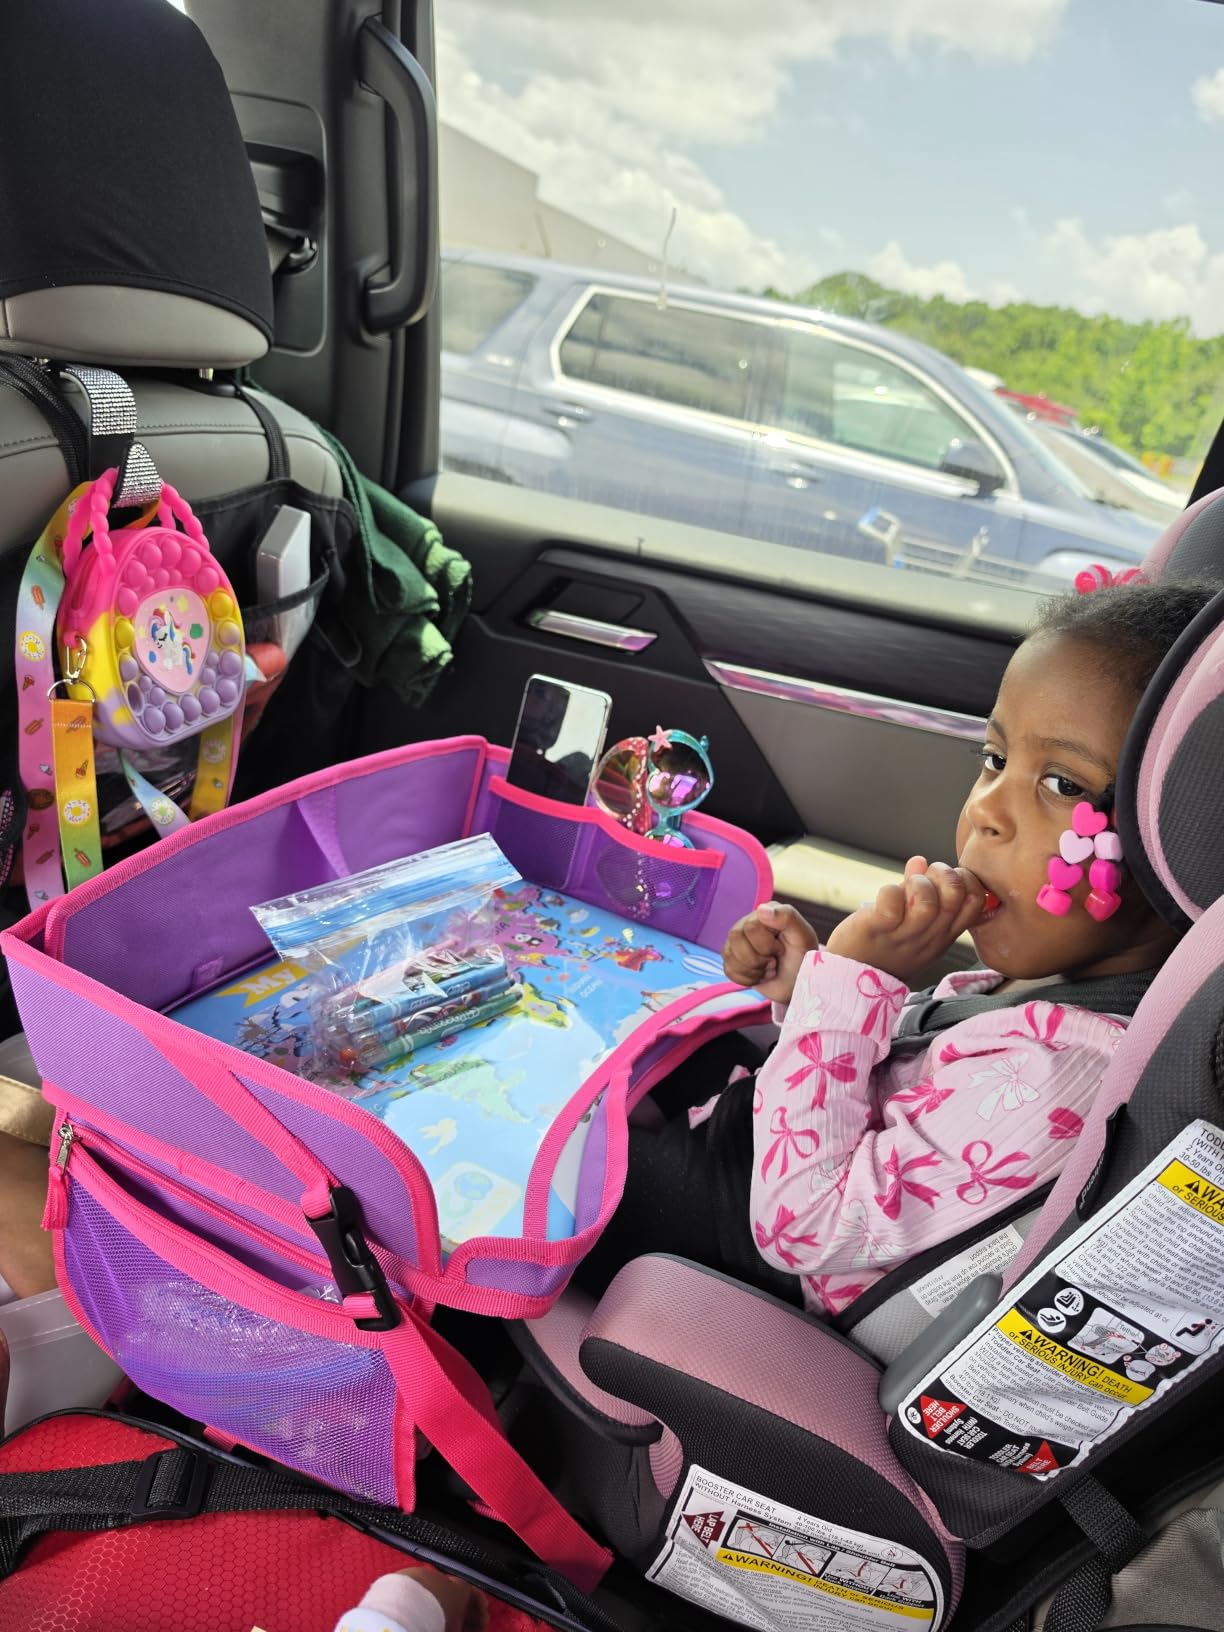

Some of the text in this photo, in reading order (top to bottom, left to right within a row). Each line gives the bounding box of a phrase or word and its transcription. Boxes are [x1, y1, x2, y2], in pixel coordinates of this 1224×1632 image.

[239, 968, 296, 995] My
[1178, 1151, 1200, 1168] 30-50
[1185, 1144, 1214, 1166] 2 Years
[1191, 1137, 1220, 1158] (WITH
[1148, 1192, 1213, 1239] child restraint around
[1155, 1185, 1223, 1235] Snugly adjust harness
[1171, 1184, 1224, 1221] or SERIOUS
[1113, 1221, 1138, 1242] system
[1137, 1238, 1145, 1246] if
[1142, 1243, 1172, 1264] available
[1122, 1216, 1191, 1266] vehicle's child restraint
[1128, 1210, 1152, 1230] Secure
[1150, 1227, 1164, 1239] this
[1163, 1236, 1180, 1249] child
[1133, 1205, 1205, 1254] provided with this child
[1141, 1198, 1220, 1254] Secure the top anchorage
[976, 1250, 994, 1265] second
[1078, 1253, 1098, 1272] Check
[1096, 1237, 1108, 1249] kg)
[1106, 1246, 1121, 1258] and
[1119, 1255, 1141, 1273] whose
[1100, 1252, 1114, 1264] and
[1102, 1232, 1117, 1245] who
[1116, 1243, 1136, 1260] weigh
[1135, 1256, 1162, 1276] between
[1161, 1273, 1172, 1282] 30
[1109, 1226, 1123, 1240] Use
[1122, 1237, 1137, 1251] only
[1136, 1248, 1150, 1260] with
[1149, 1257, 1175, 1275] children
[1083, 1248, 1102, 1265] Latch
[1100, 1263, 1115, 1276] may
[1123, 1278, 1140, 1291] used
[967, 1363, 981, 1376] Belt
[974, 1351, 1011, 1381] shoulder belt
[978, 1345, 996, 1363] WITH
[1000, 1363, 1019, 1377] tether
[982, 1341, 1042, 1383] installation based on
[990, 1335, 1056, 1384] Toddler Car Seat Use
[991, 1326, 1014, 1347] Proper
[1012, 1343, 1036, 1363] vehicle
[1034, 1359, 1062, 1378] shoulder
[1062, 1375, 1076, 1386] belt
[1008, 1331, 1019, 1340] or
[1019, 1338, 1057, 1364] SERIOUS
[1056, 1361, 1088, 1381] INJURY
[1088, 1379, 1104, 1390] can
[1033, 1335, 1104, 1379] WARNING!
[1101, 1375, 1131, 1393] DEATH
[922, 1400, 939, 1416] HERE
[929, 1405, 959, 1432] SHOULDER
[930, 1406, 946, 1421] BELT
[949, 1373, 973, 1396] Booster
[972, 1393, 985, 1404] Car
[984, 1400, 1000, 1412] Seat
[1002, 1409, 1015, 1420] DO
[1013, 1415, 1029, 1427] NOT
[694, 1481, 792, 1527] WITHOUT Harness System
[695, 1475, 776, 1514] BOOSTER CAR SEAT
[689, 1513, 705, 1533] HERE
[698, 1525, 714, 1543] BELT
[803, 1517, 820, 1528] Years
[736, 1554, 812, 1584] WARNING!
